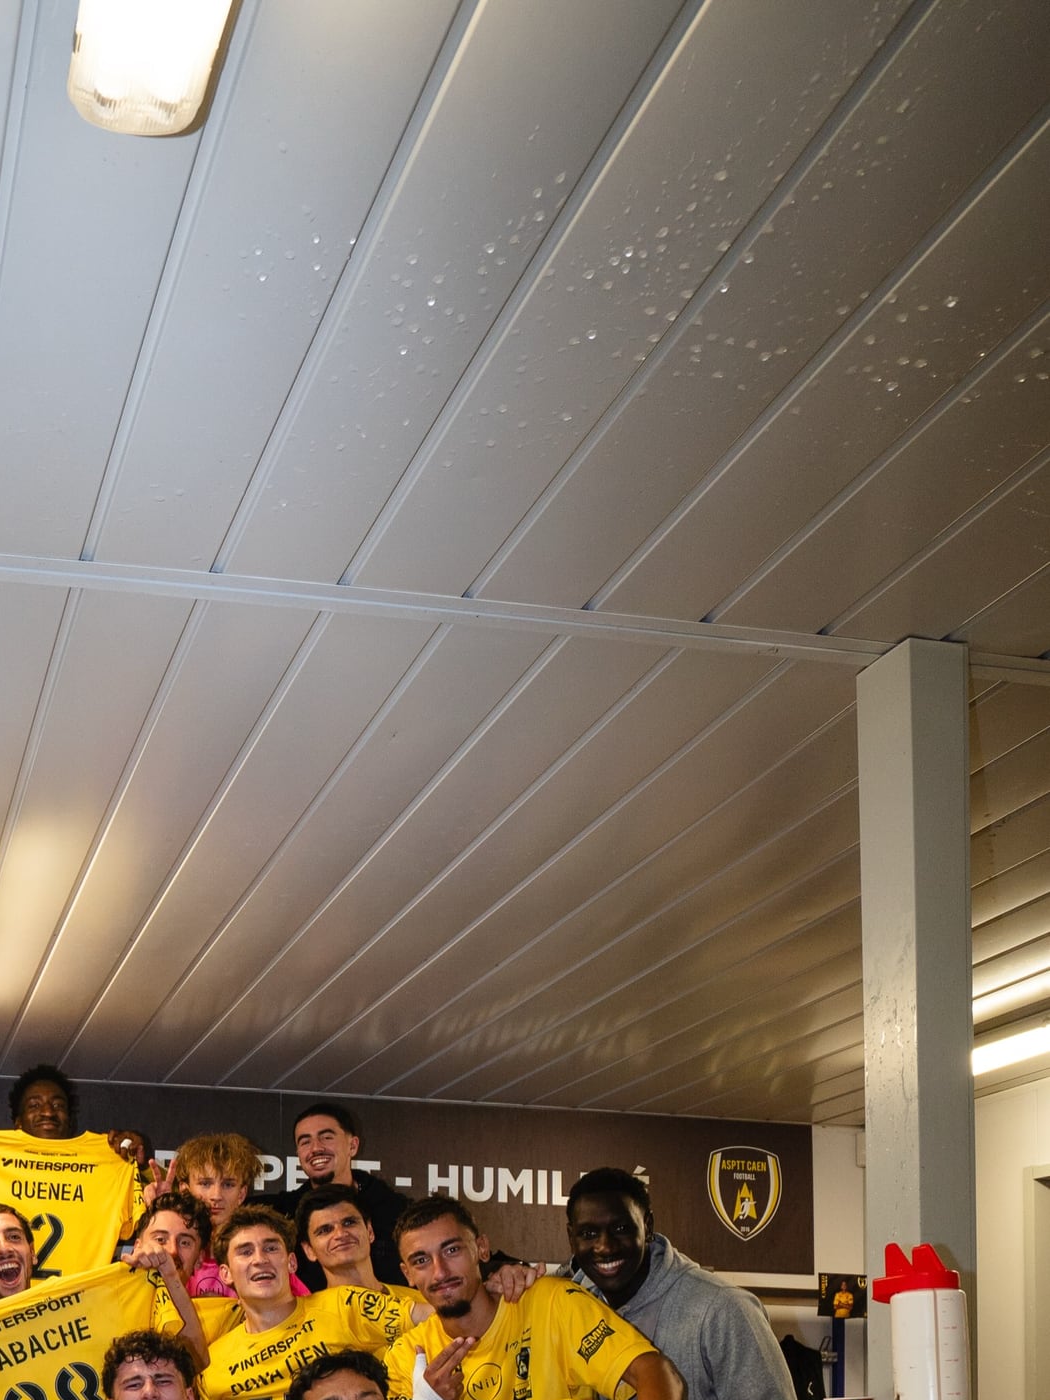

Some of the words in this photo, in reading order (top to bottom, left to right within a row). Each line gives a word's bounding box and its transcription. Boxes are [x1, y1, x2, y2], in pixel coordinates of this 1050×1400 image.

[14, 1158, 96, 1173] INTERSPORT
[721, 1160, 745, 1170] ASPTT
[747, 1161, 766, 1172] CAEN
[11, 1179, 84, 1202] QUENEA
